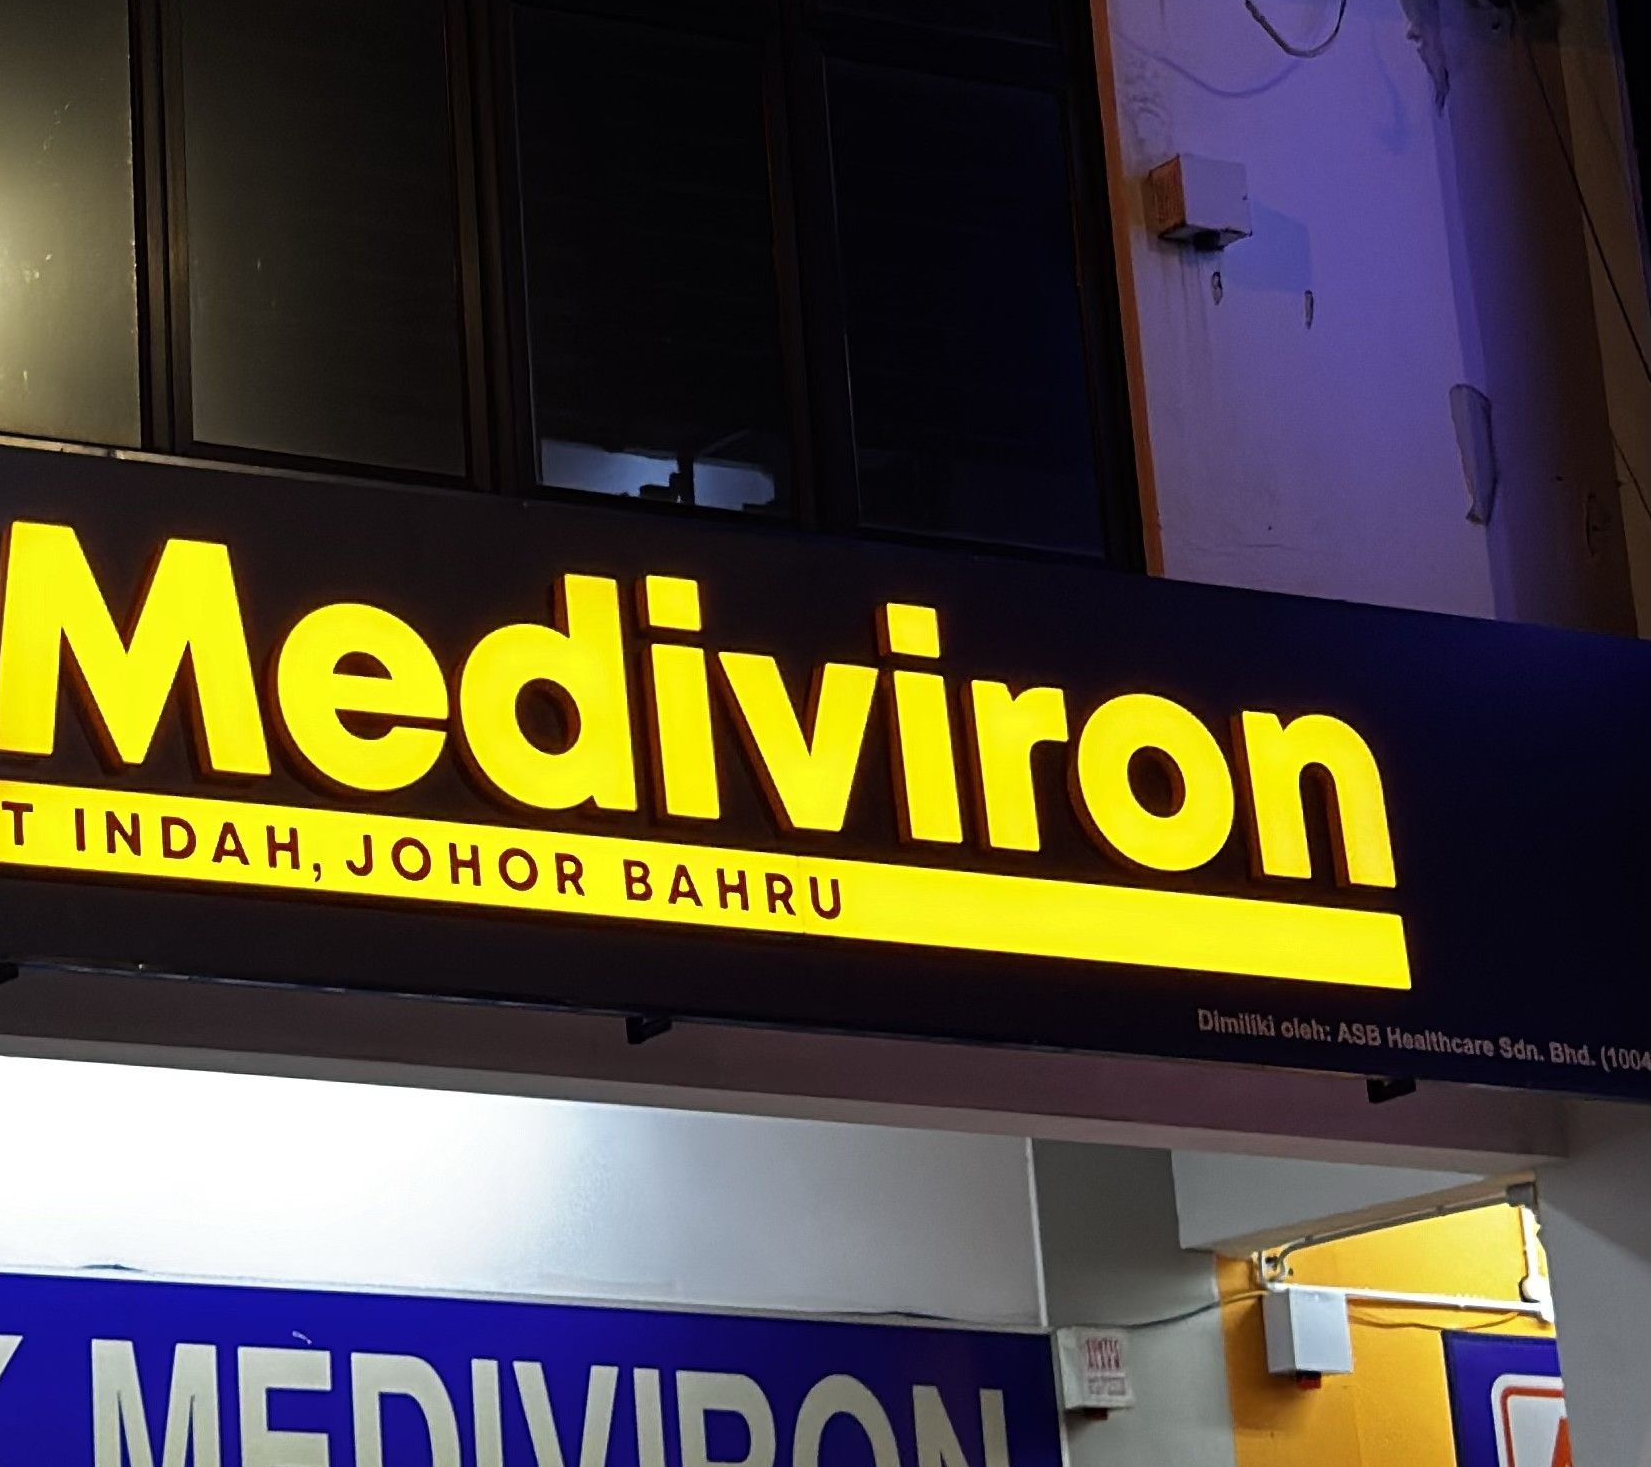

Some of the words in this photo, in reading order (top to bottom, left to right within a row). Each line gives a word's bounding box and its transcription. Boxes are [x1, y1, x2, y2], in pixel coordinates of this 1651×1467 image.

[72, 806, 323, 884] INDAH,
[344, 833, 585, 897] JOHOR
[622, 859, 846, 921] BAHRU
[1280, 1018, 1333, 1044] oleh:
[1337, 1022, 1381, 1048] ASB
[1387, 1026, 1495, 1059] Healthcare
[1499, 1035, 1545, 1063] Sdn.
[1549, 1040, 1597, 1067] Bhd.
